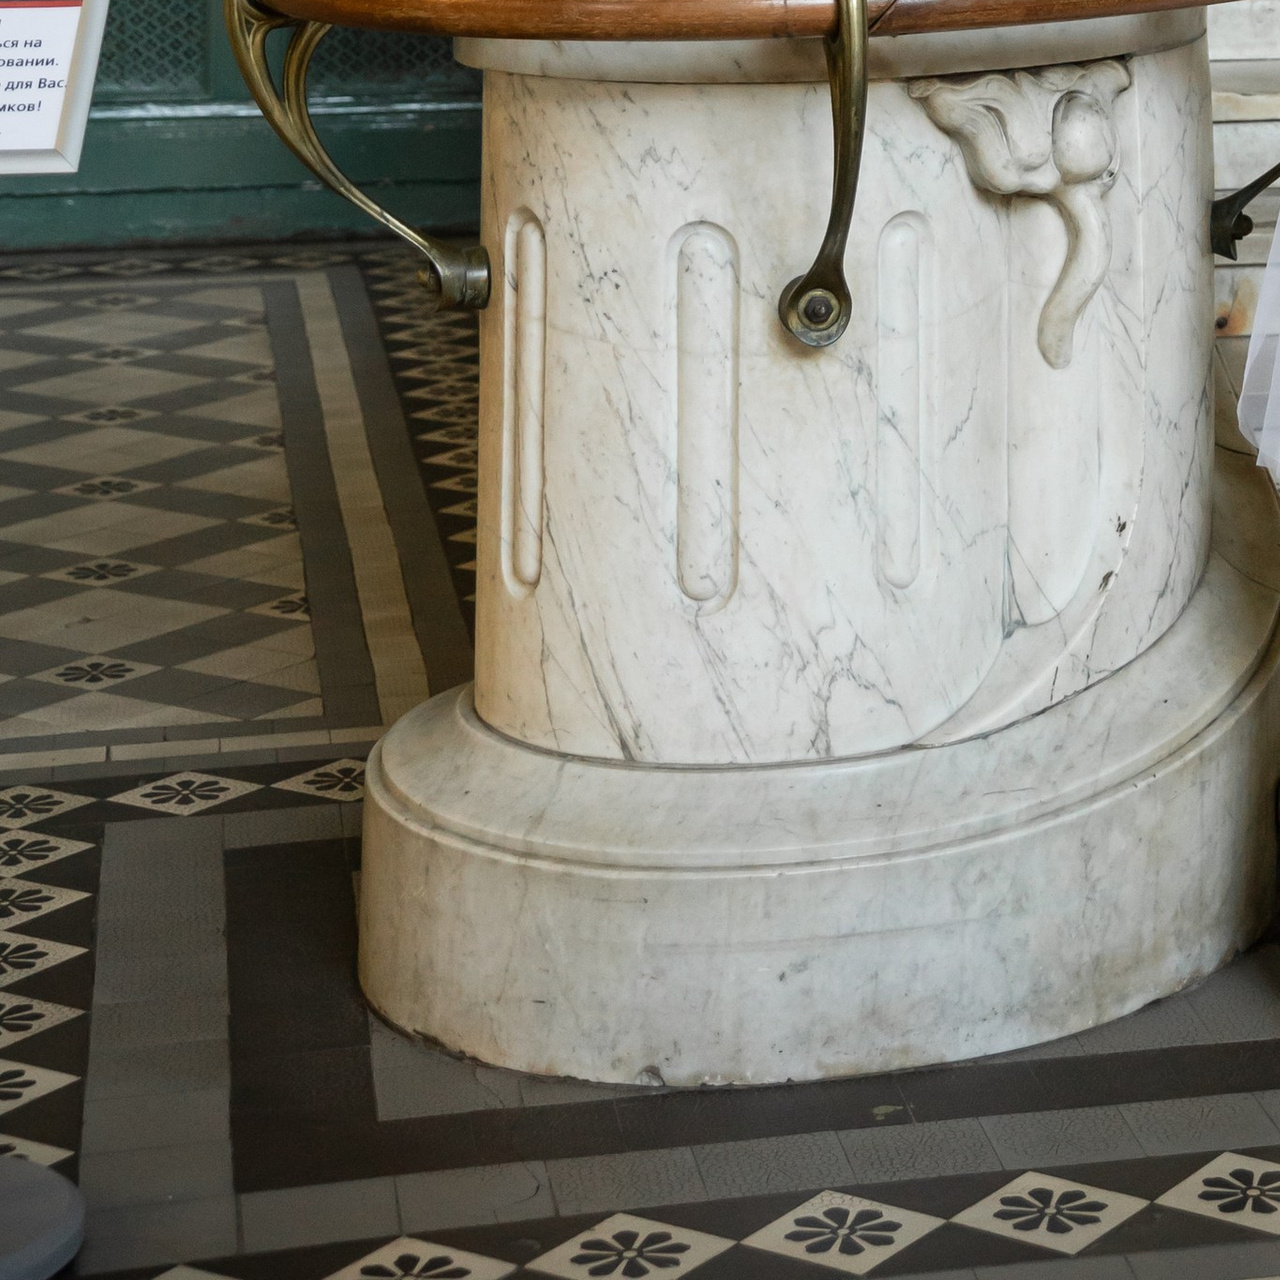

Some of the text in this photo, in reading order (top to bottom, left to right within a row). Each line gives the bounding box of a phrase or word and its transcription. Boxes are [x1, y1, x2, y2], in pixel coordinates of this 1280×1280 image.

[23, 39, 42, 48] на
[4, 77, 67, 91] для Вас.
